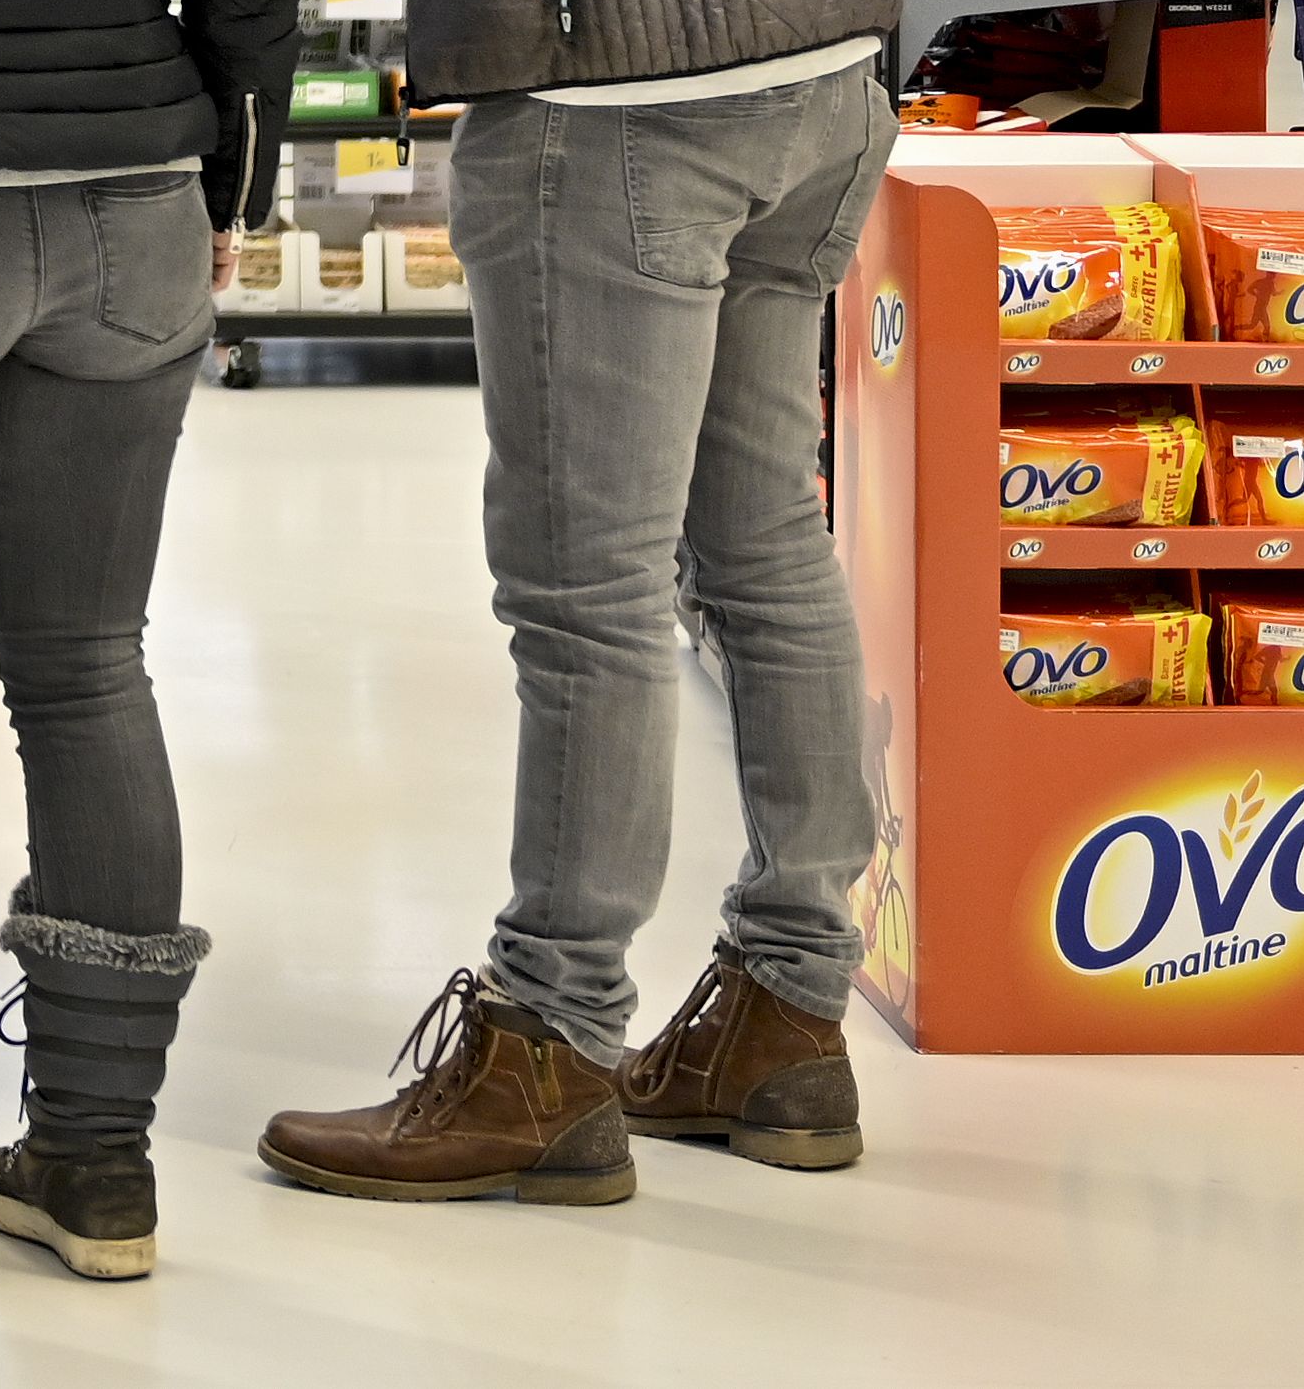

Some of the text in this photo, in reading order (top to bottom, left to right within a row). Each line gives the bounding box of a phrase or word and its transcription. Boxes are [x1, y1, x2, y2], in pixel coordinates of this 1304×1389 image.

[1004, 297, 1050, 317] maltine
[1023, 497, 1070, 514] maltine
[1171, 647, 1186, 702] OFFERTE
[1029, 681, 1077, 697] maltine
[1144, 933, 1287, 988] maltine
